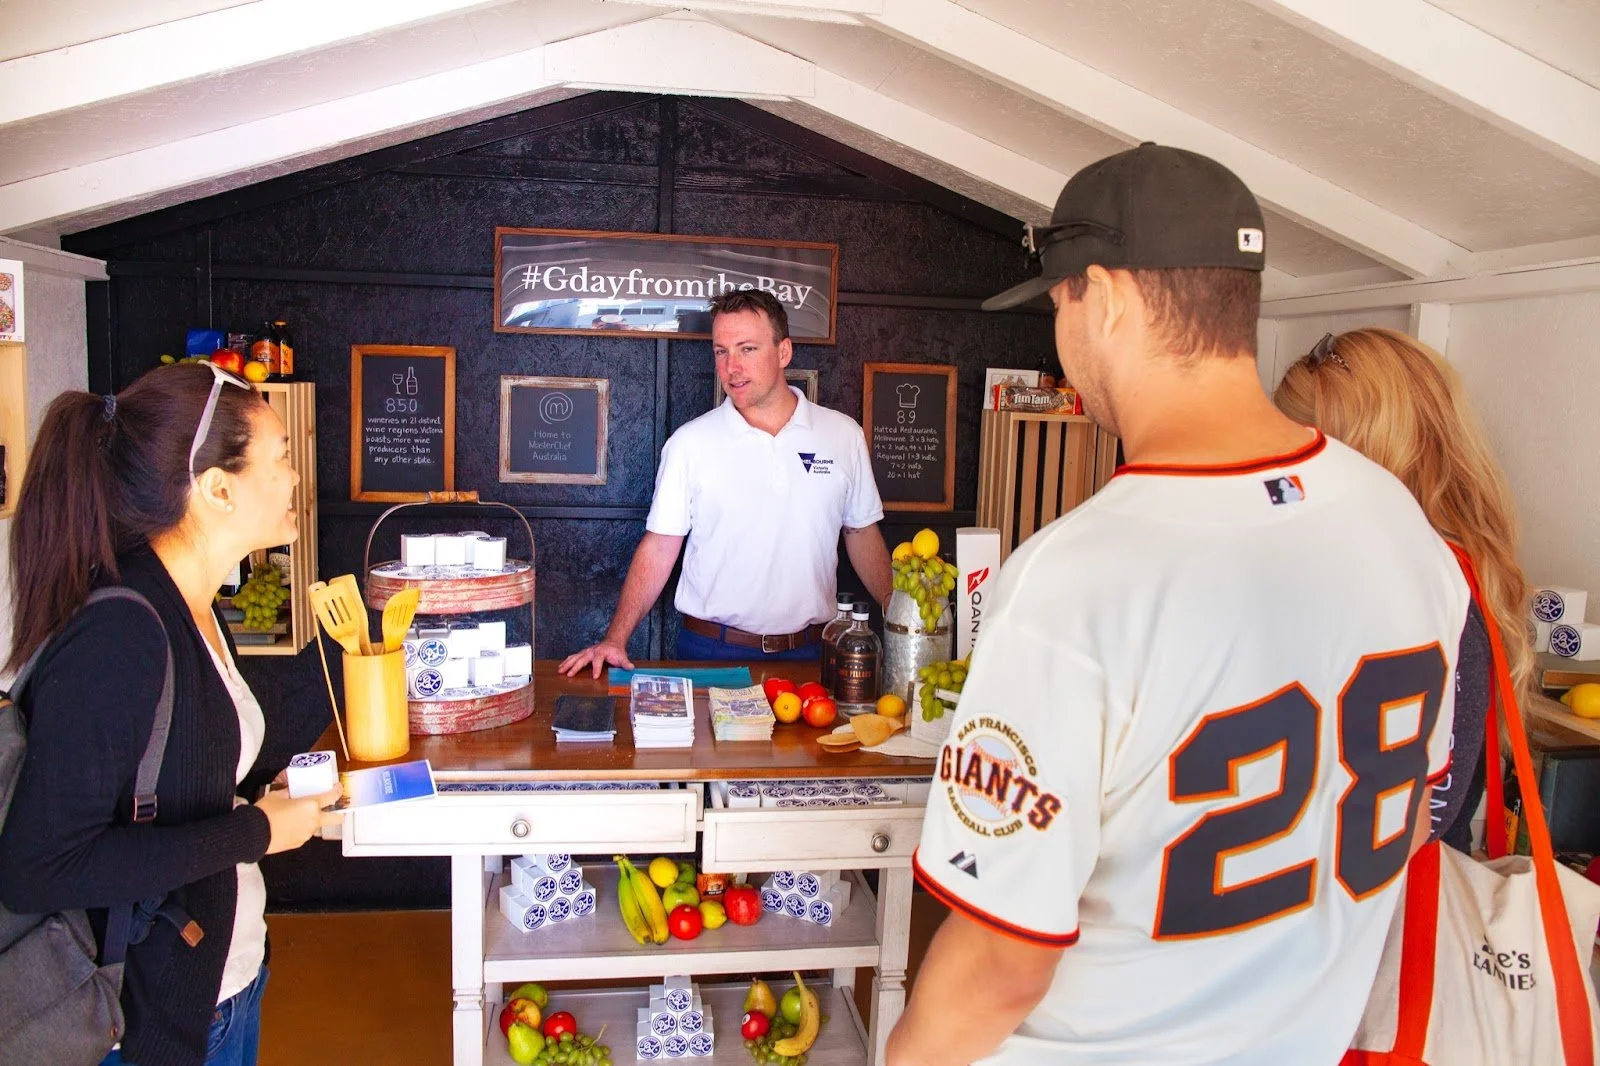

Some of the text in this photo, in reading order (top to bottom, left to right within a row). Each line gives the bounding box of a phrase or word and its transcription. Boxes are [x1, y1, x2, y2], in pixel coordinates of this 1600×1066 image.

[521, 265, 812, 309] #GdayfromtheBay
[386, 398, 417, 412] 850
[367, 416, 400, 424] wineries
[409, 416, 417, 424] 21
[418, 416, 441, 424] distinct
[896, 410, 916, 424] 89
[420, 426, 443, 434] Victoria
[534, 430, 571, 439] Home to
[366, 435, 391, 443] boasts
[368, 445, 431, 455] producers than
[528, 440, 572, 450] MasterChef
[374, 456, 388, 465] any
[392, 455, 412, 463] other
[532, 451, 567, 461] Australia
[877, 452, 905, 461] Regional
[971, 591, 982, 648] QAN
[957, 717, 1037, 777] SAN FRANCISCO
[940, 744, 1062, 832] GIANTS
[1152, 640, 1448, 942] 28
[947, 786, 1023, 837] BASEBALL CLUB
